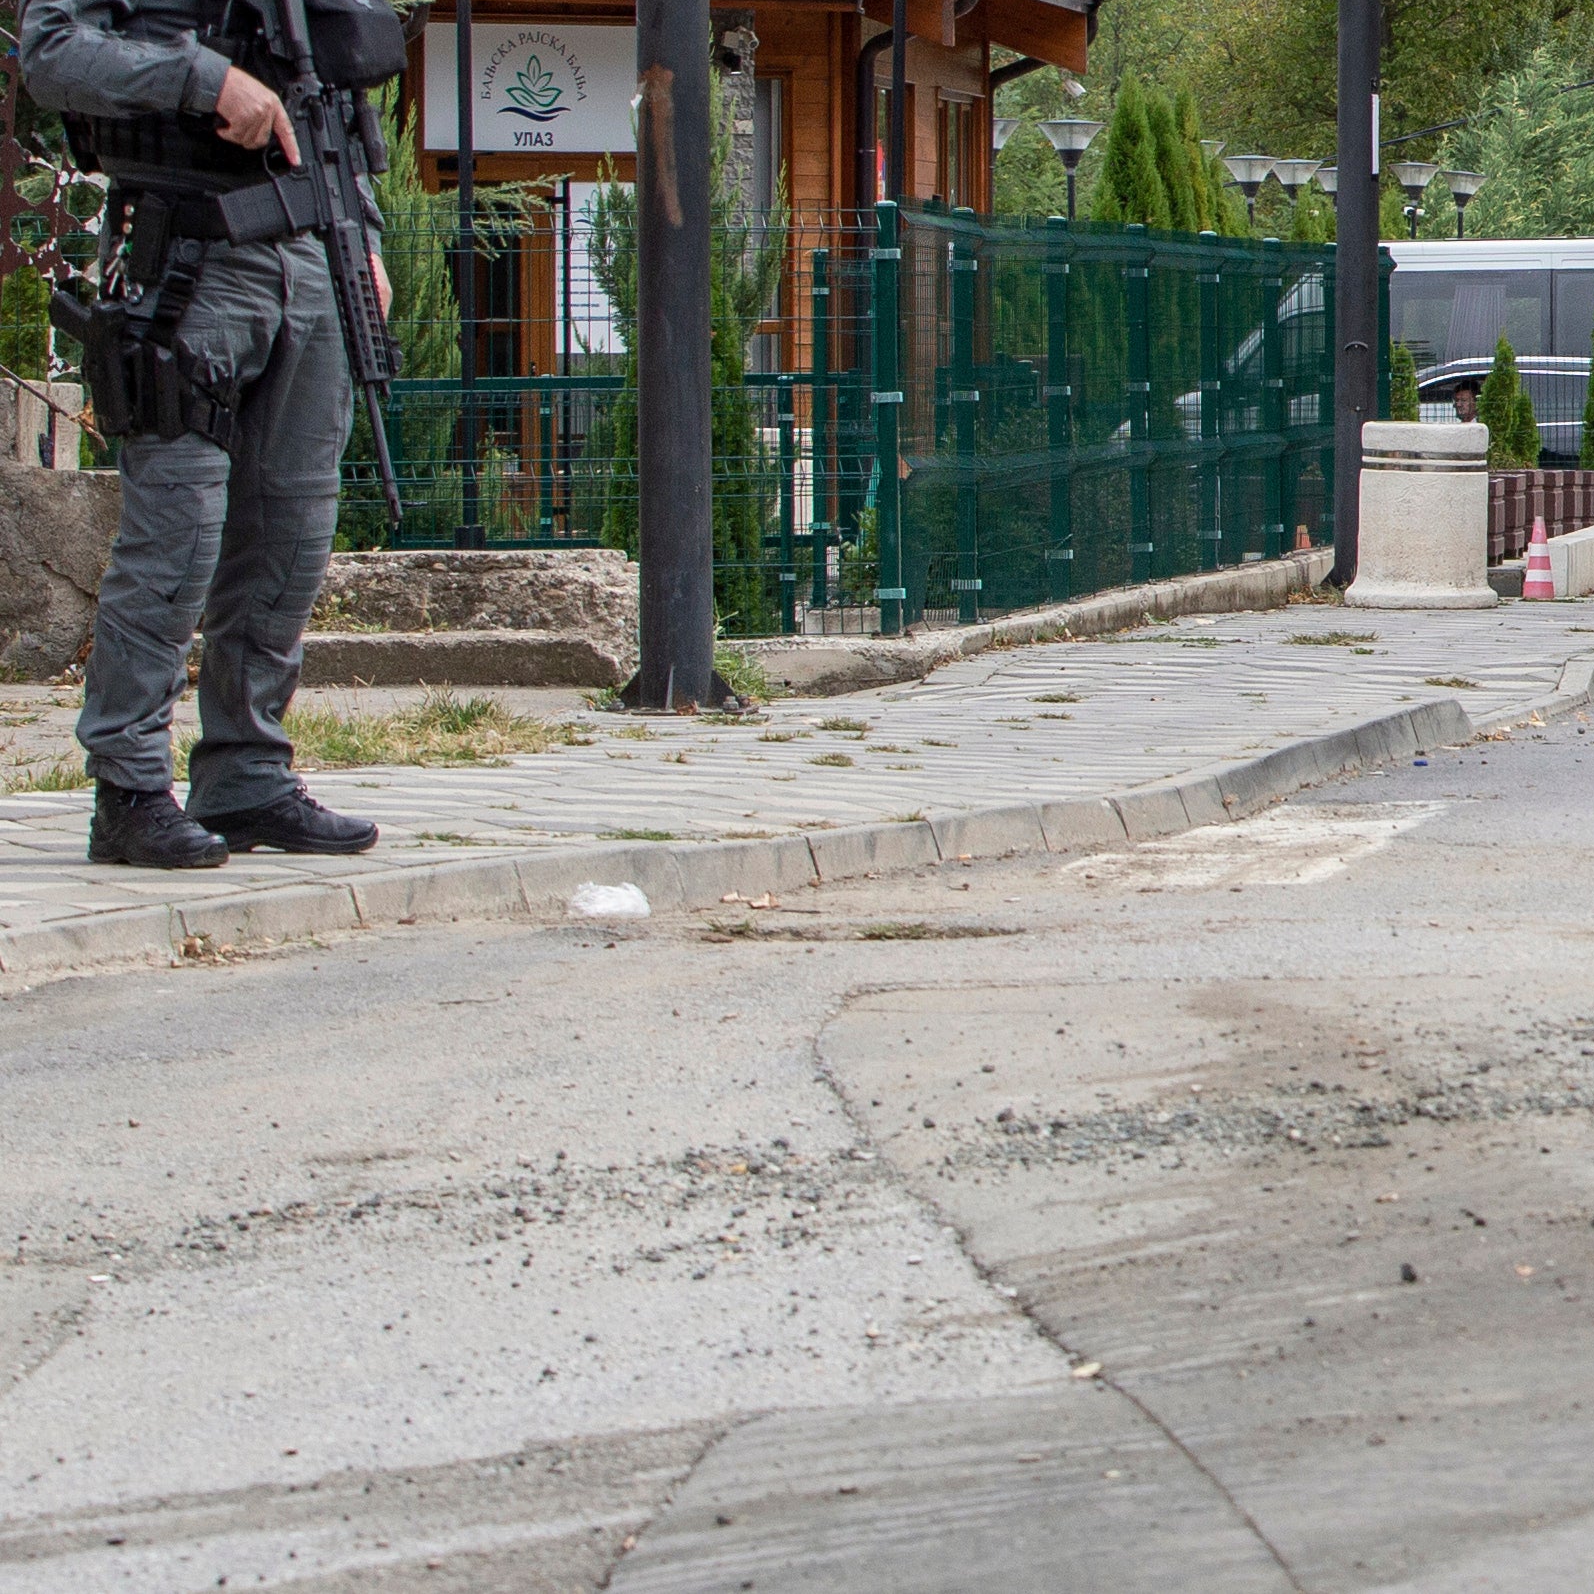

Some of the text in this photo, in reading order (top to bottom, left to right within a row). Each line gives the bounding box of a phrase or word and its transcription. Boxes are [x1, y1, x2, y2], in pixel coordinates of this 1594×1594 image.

[481, 31, 588, 101] БАЊСКА РАЈСКА БАЊА
[513, 131, 554, 147] УЛАЗ
